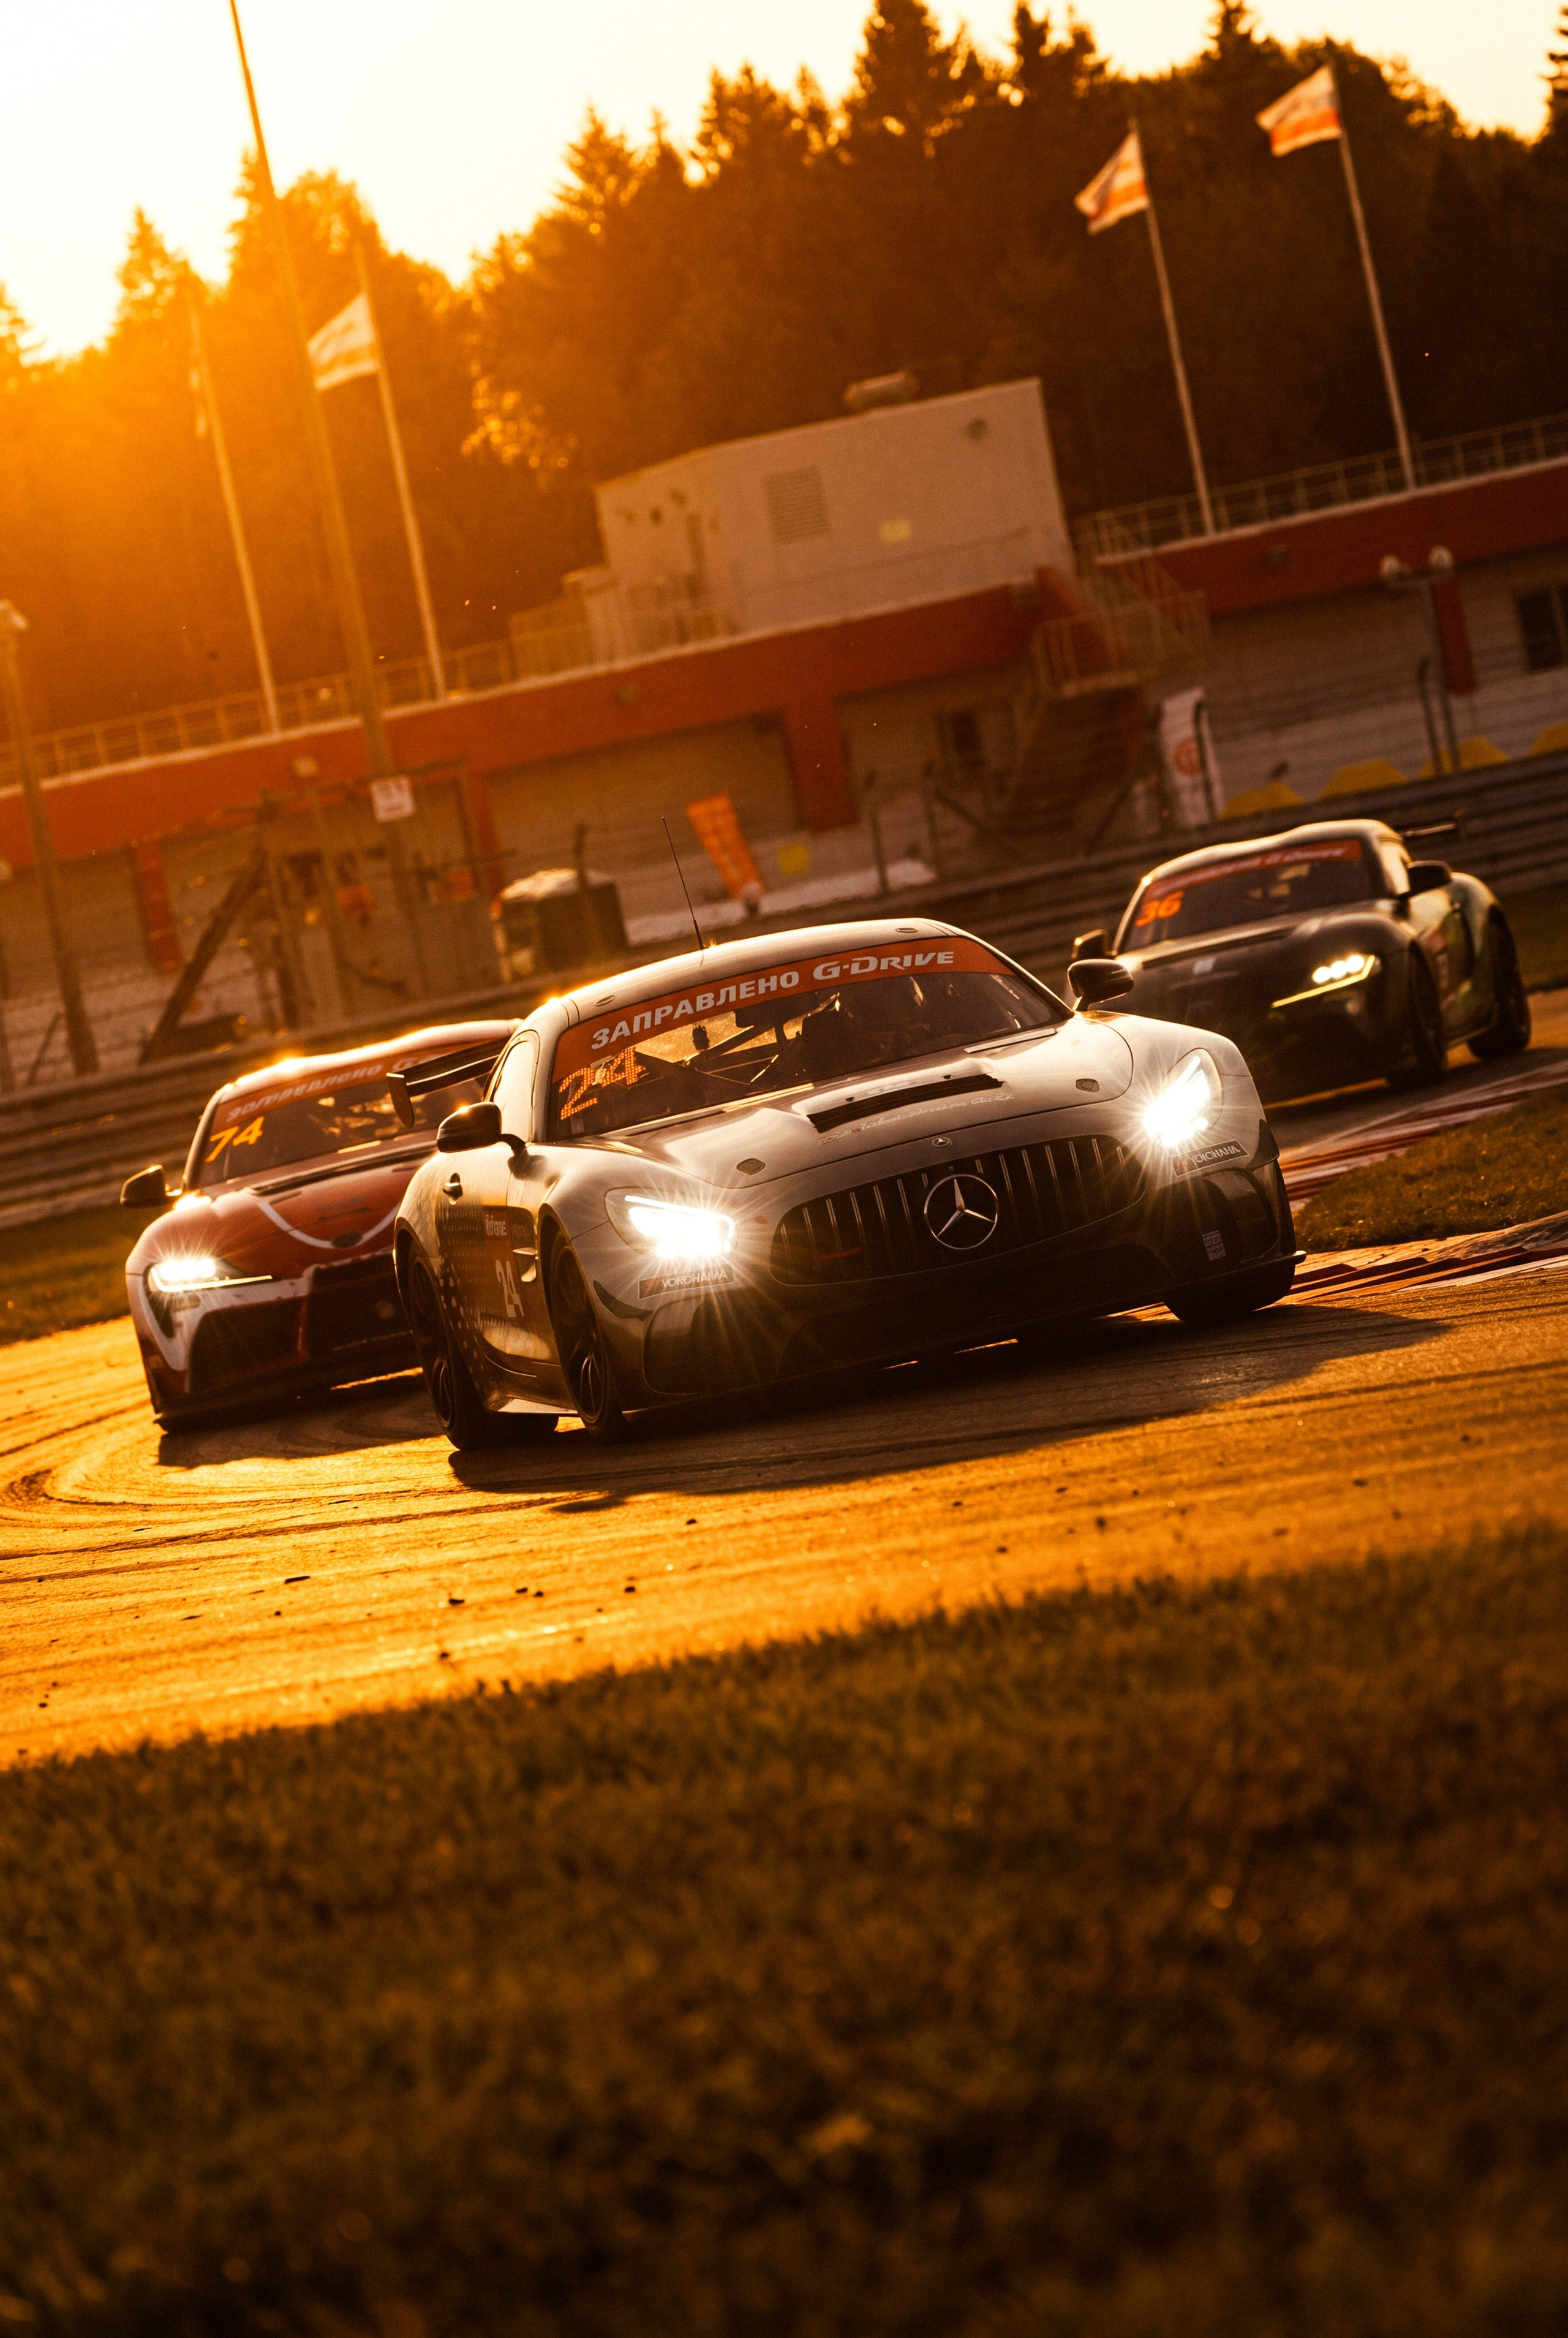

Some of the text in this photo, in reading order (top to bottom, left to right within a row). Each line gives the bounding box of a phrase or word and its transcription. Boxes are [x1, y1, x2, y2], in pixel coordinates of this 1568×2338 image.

[591, 951, 954, 1050] ЗАПРАВЛЕНО G-DRIVE
[559, 1045, 646, 1120] 24
[205, 1116, 265, 1163] 74
[495, 1260, 524, 1317] 24
[662, 1269, 728, 1288] YOKOHAMA
